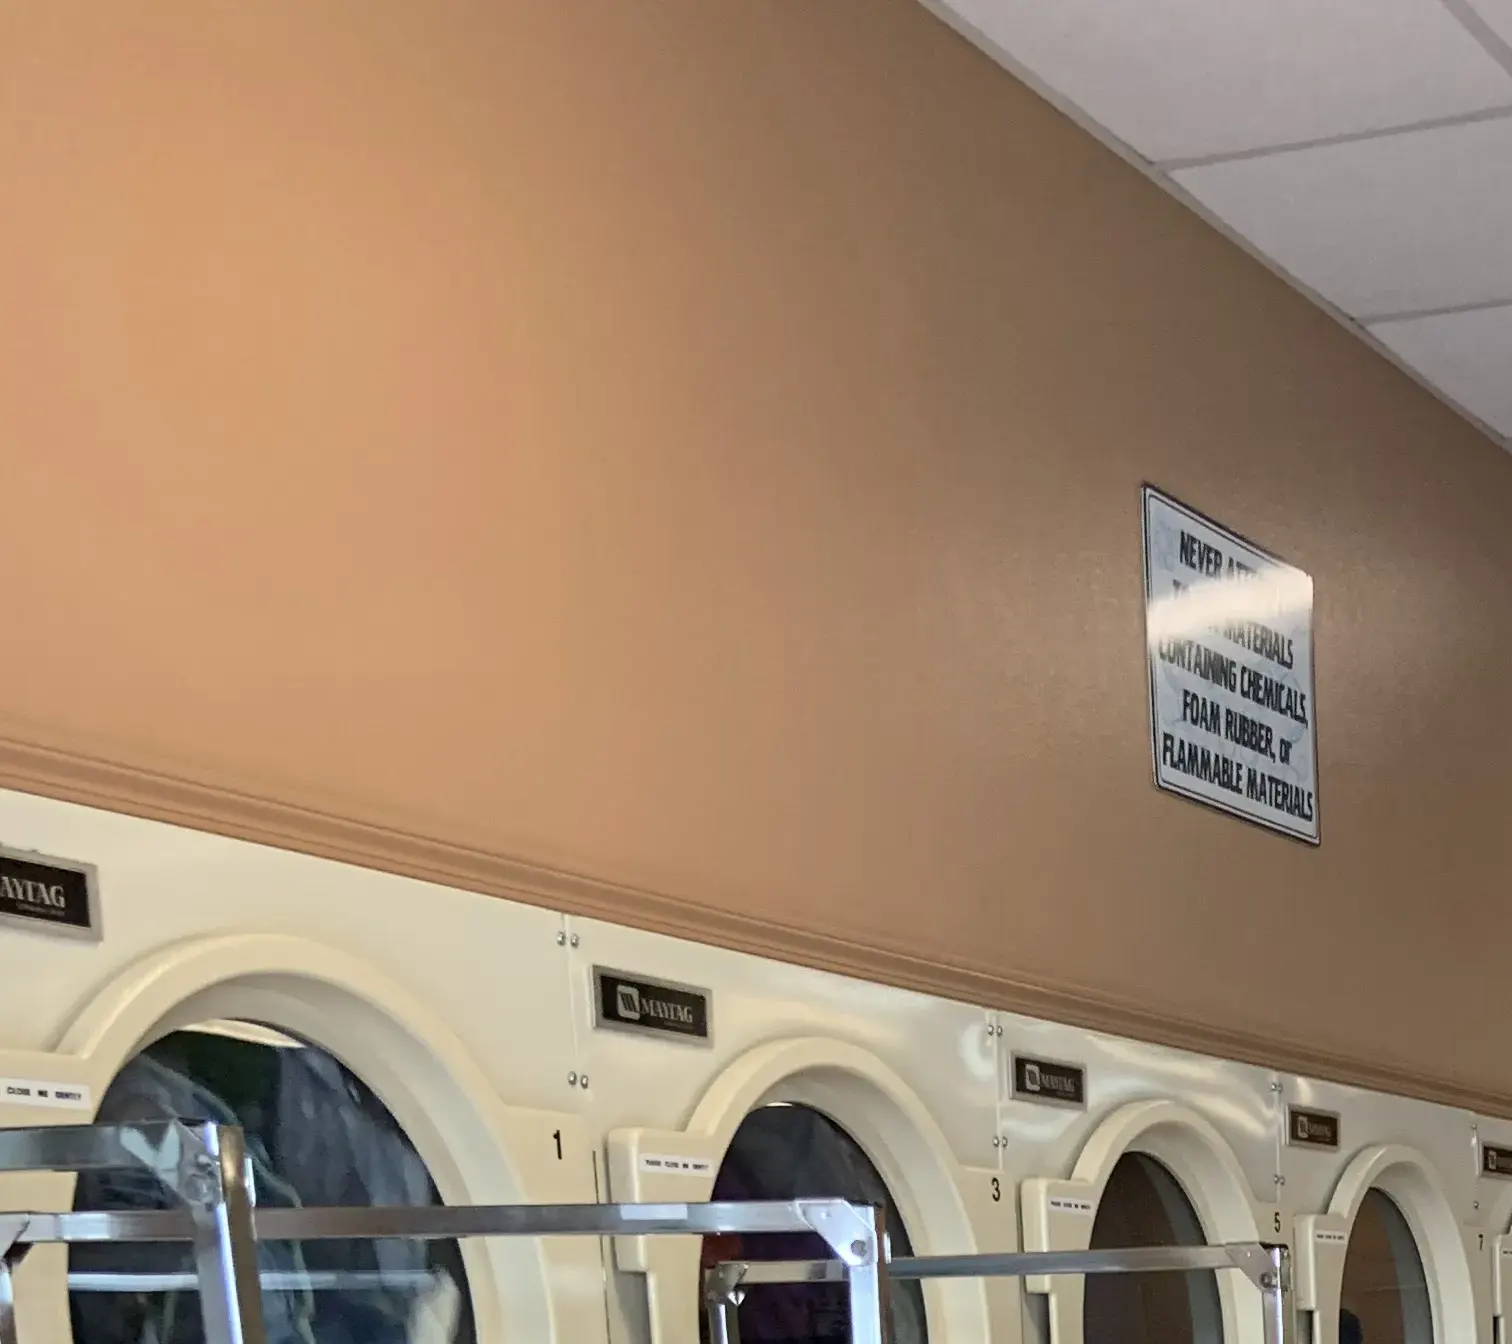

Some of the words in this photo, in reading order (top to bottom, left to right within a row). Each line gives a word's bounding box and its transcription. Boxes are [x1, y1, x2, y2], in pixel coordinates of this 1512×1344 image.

[1179, 531, 1223, 580] NEVER
[1159, 636, 1237, 693] CONTAINING
[1240, 665, 1308, 728] CHEMICALS,
[1183, 689, 1221, 737] FOAM
[1225, 708, 1276, 763] RUBBER,
[1163, 732, 1243, 795] FLAMMABLE
[1246, 767, 1313, 822] MATERIALS
[0, 876, 65, 908] AYTAG
[640, 997, 693, 1023] MAYTAG
[553, 1129, 563, 1160] 1
[992, 1177, 1001, 1202] 3
[1274, 1211, 1281, 1233] 5
